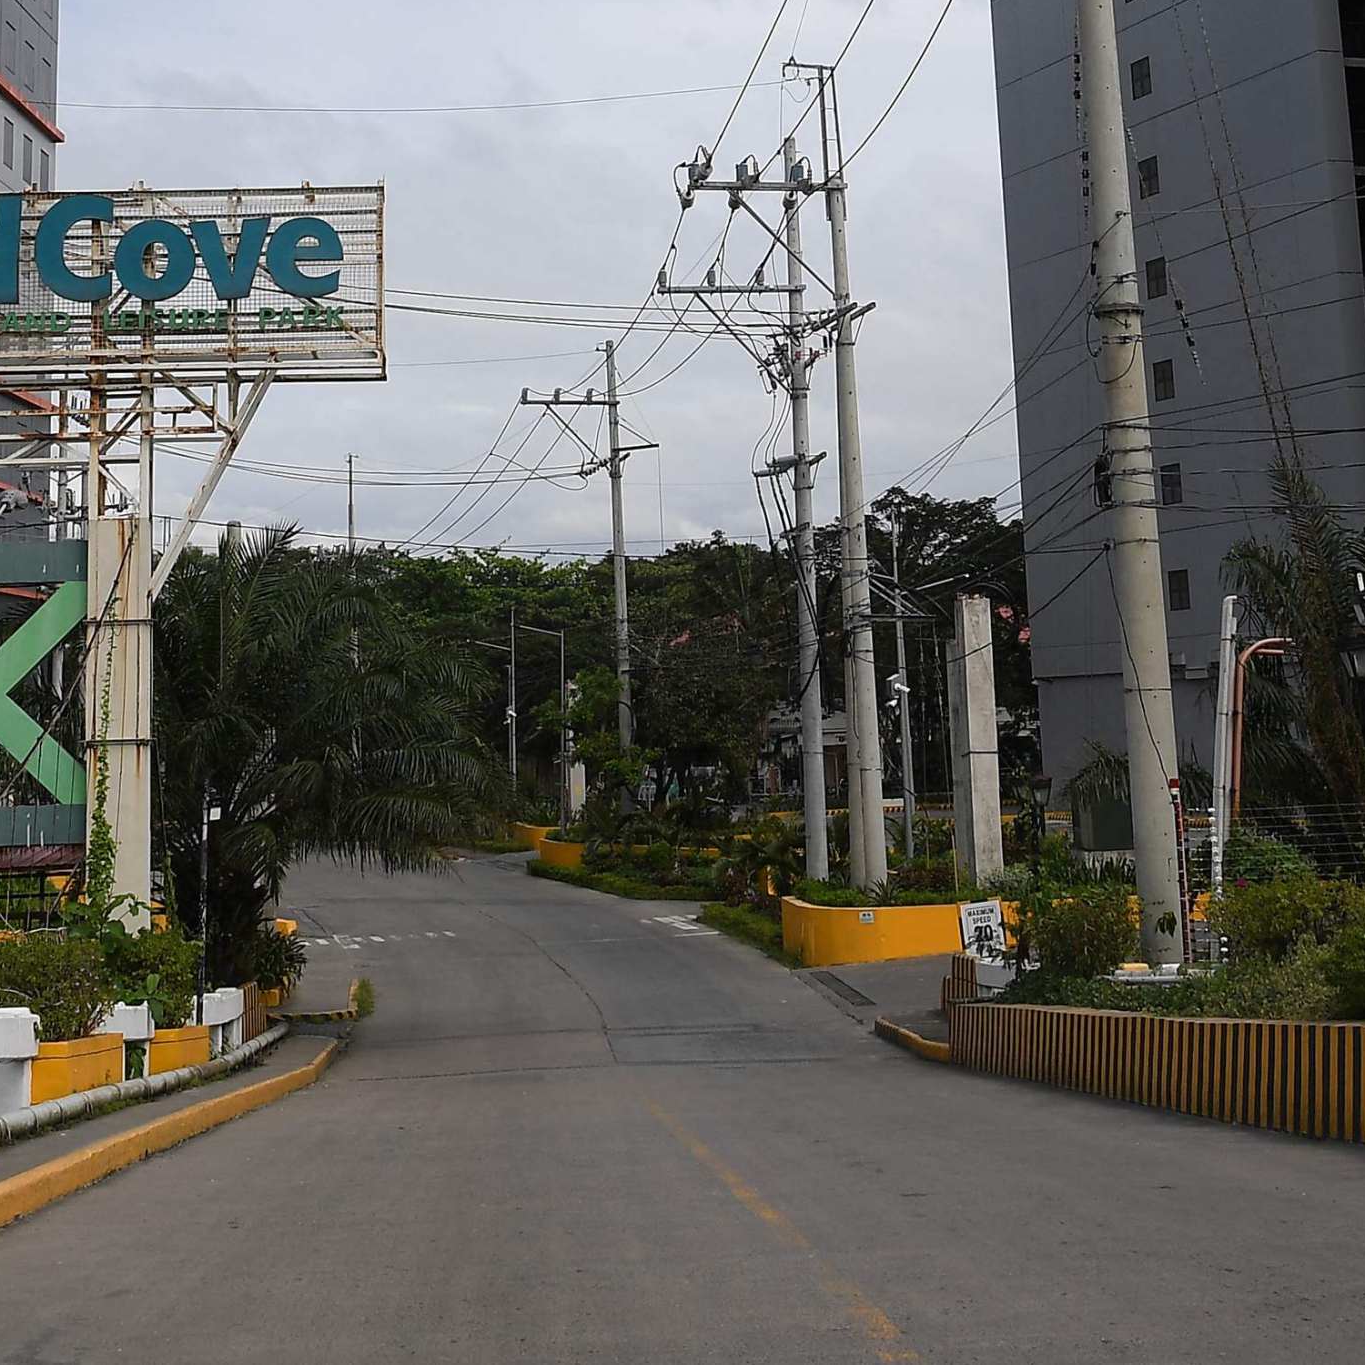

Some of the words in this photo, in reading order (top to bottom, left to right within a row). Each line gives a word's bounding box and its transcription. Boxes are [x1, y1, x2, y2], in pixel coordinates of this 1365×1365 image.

[0, 311, 72, 333] AND
[102, 308, 229, 332] LEISURE
[259, 306, 345, 330] PARK
[972, 916, 992, 925] SPEED
